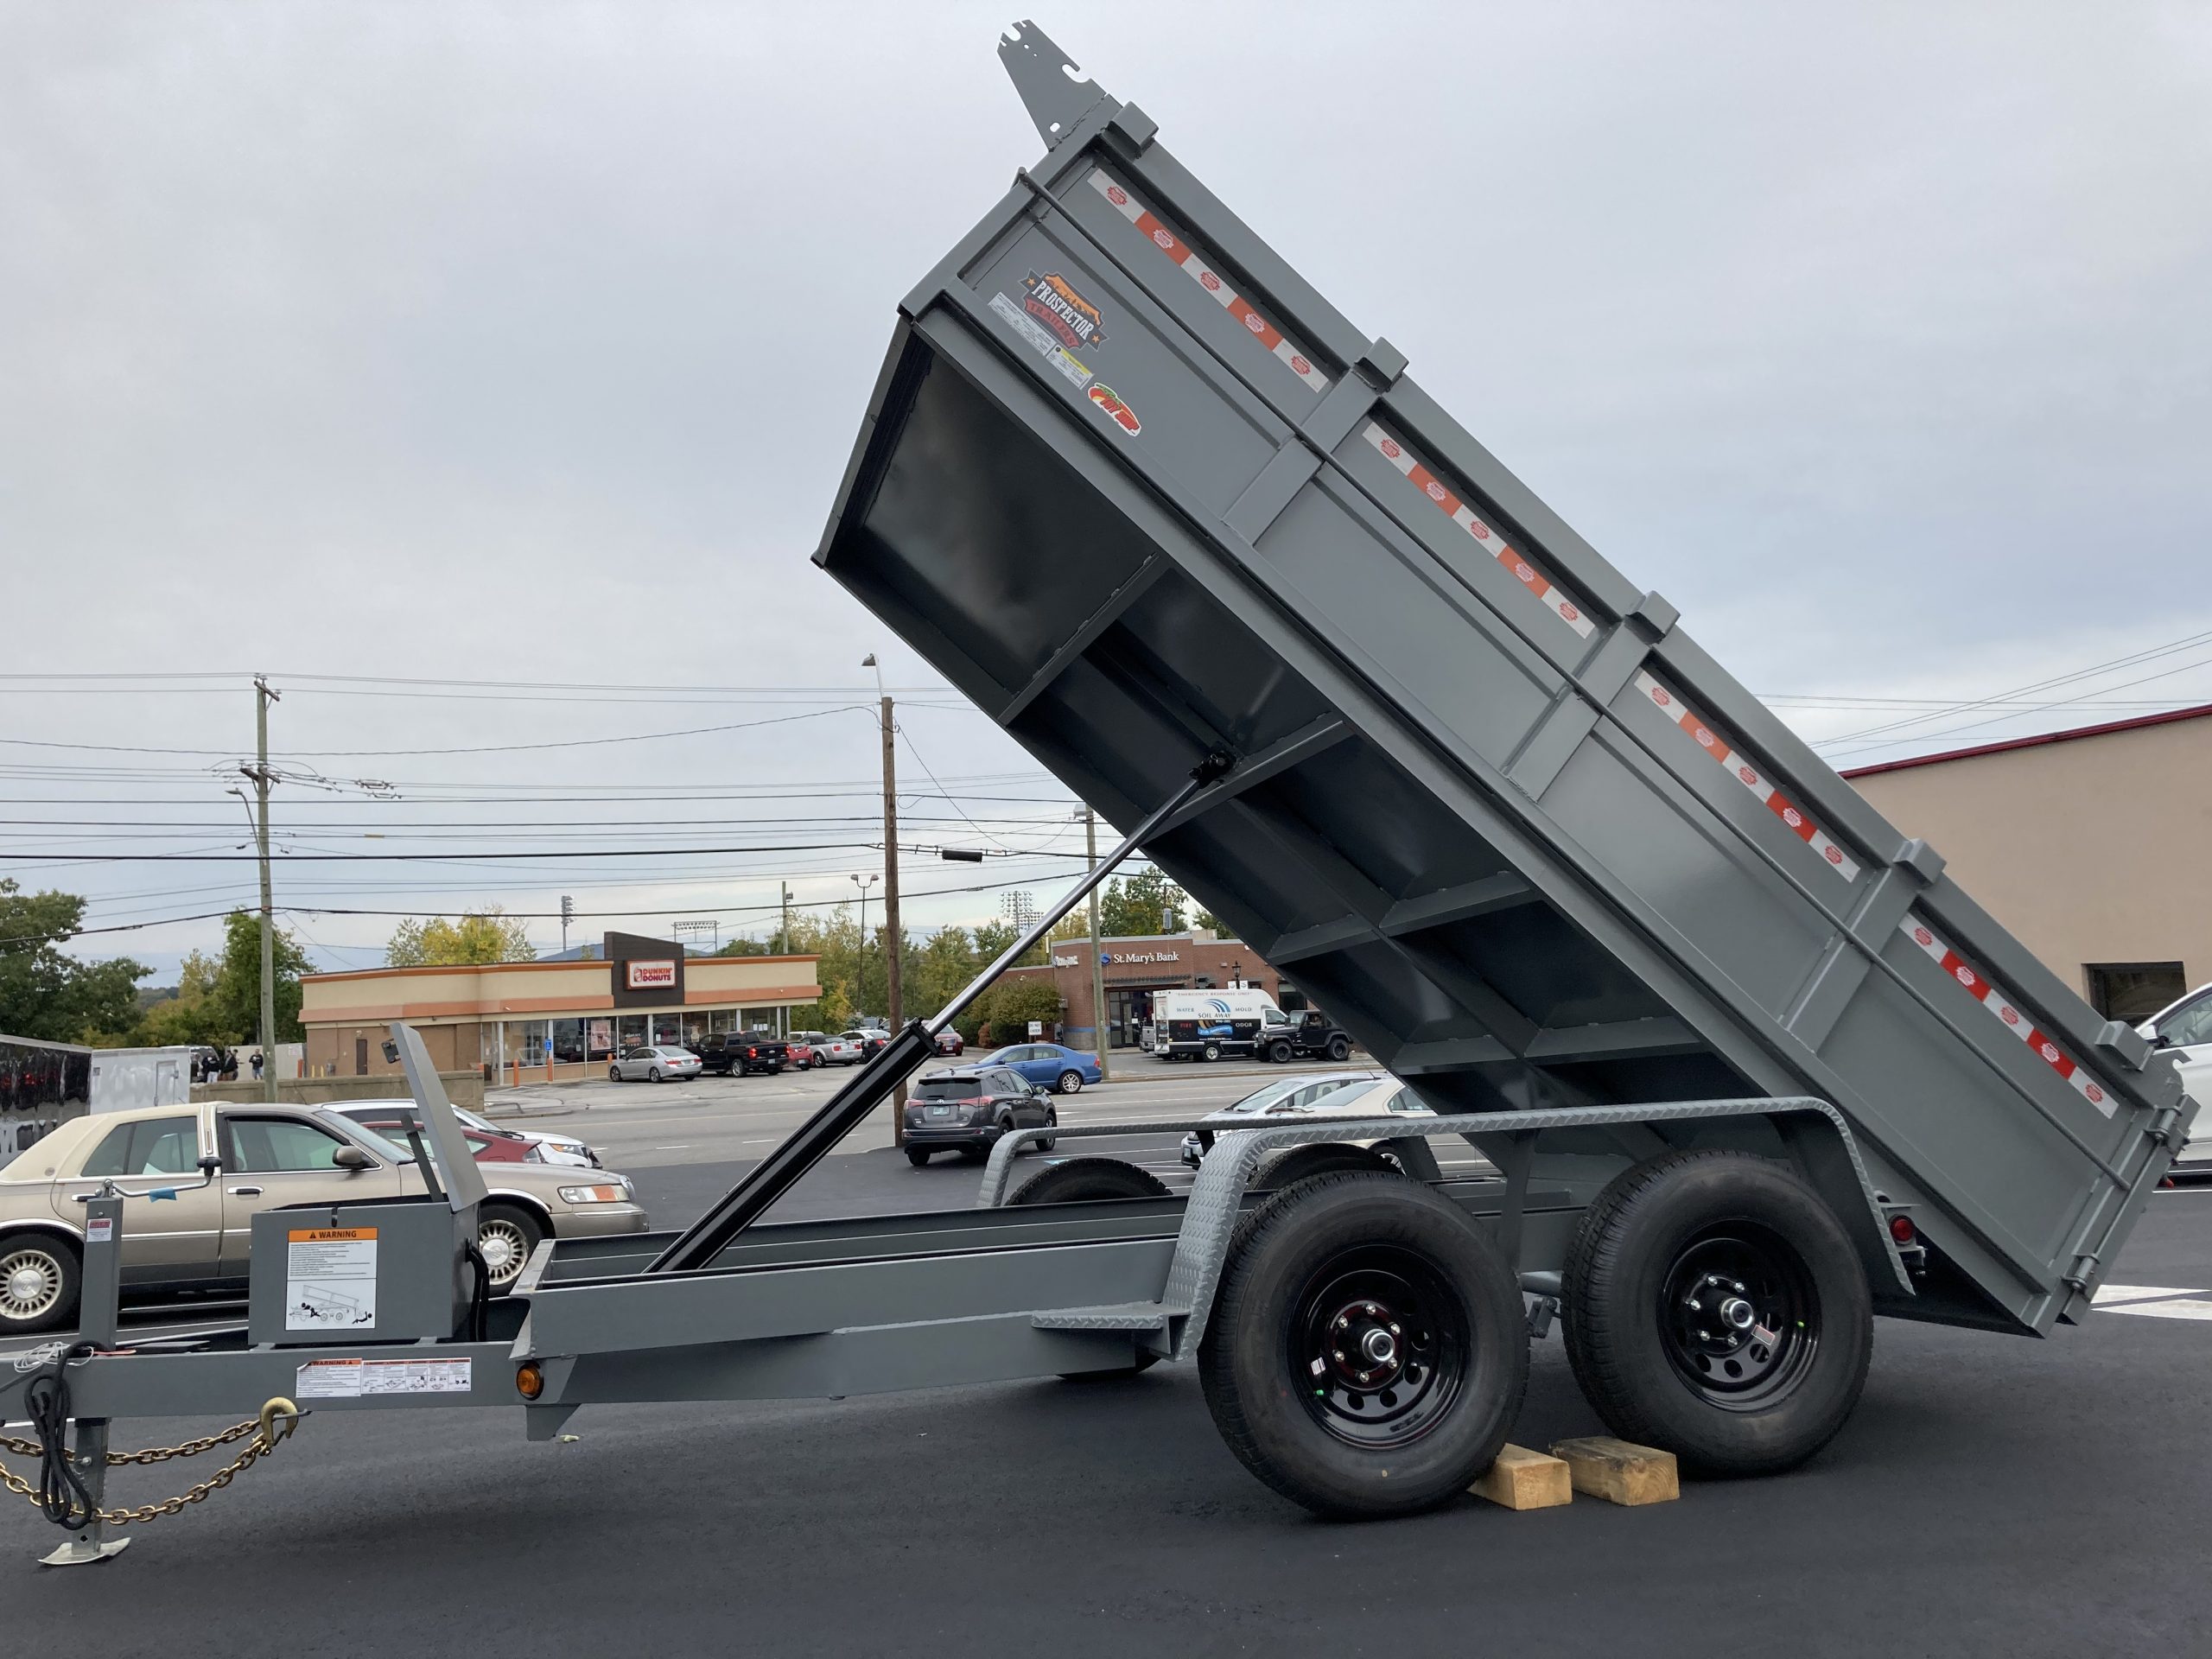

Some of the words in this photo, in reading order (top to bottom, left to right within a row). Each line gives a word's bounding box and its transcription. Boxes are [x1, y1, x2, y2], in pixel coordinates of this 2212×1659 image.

[1030, 302, 1074, 344] TRAILERS
[1032, 280, 1094, 340] PROSPECTOR
[1114, 953, 1125, 963] St.
[1126, 952, 1155, 965] Mary's
[1156, 950, 1179, 962] Bank
[319, 1230, 357, 1239] WARNING
